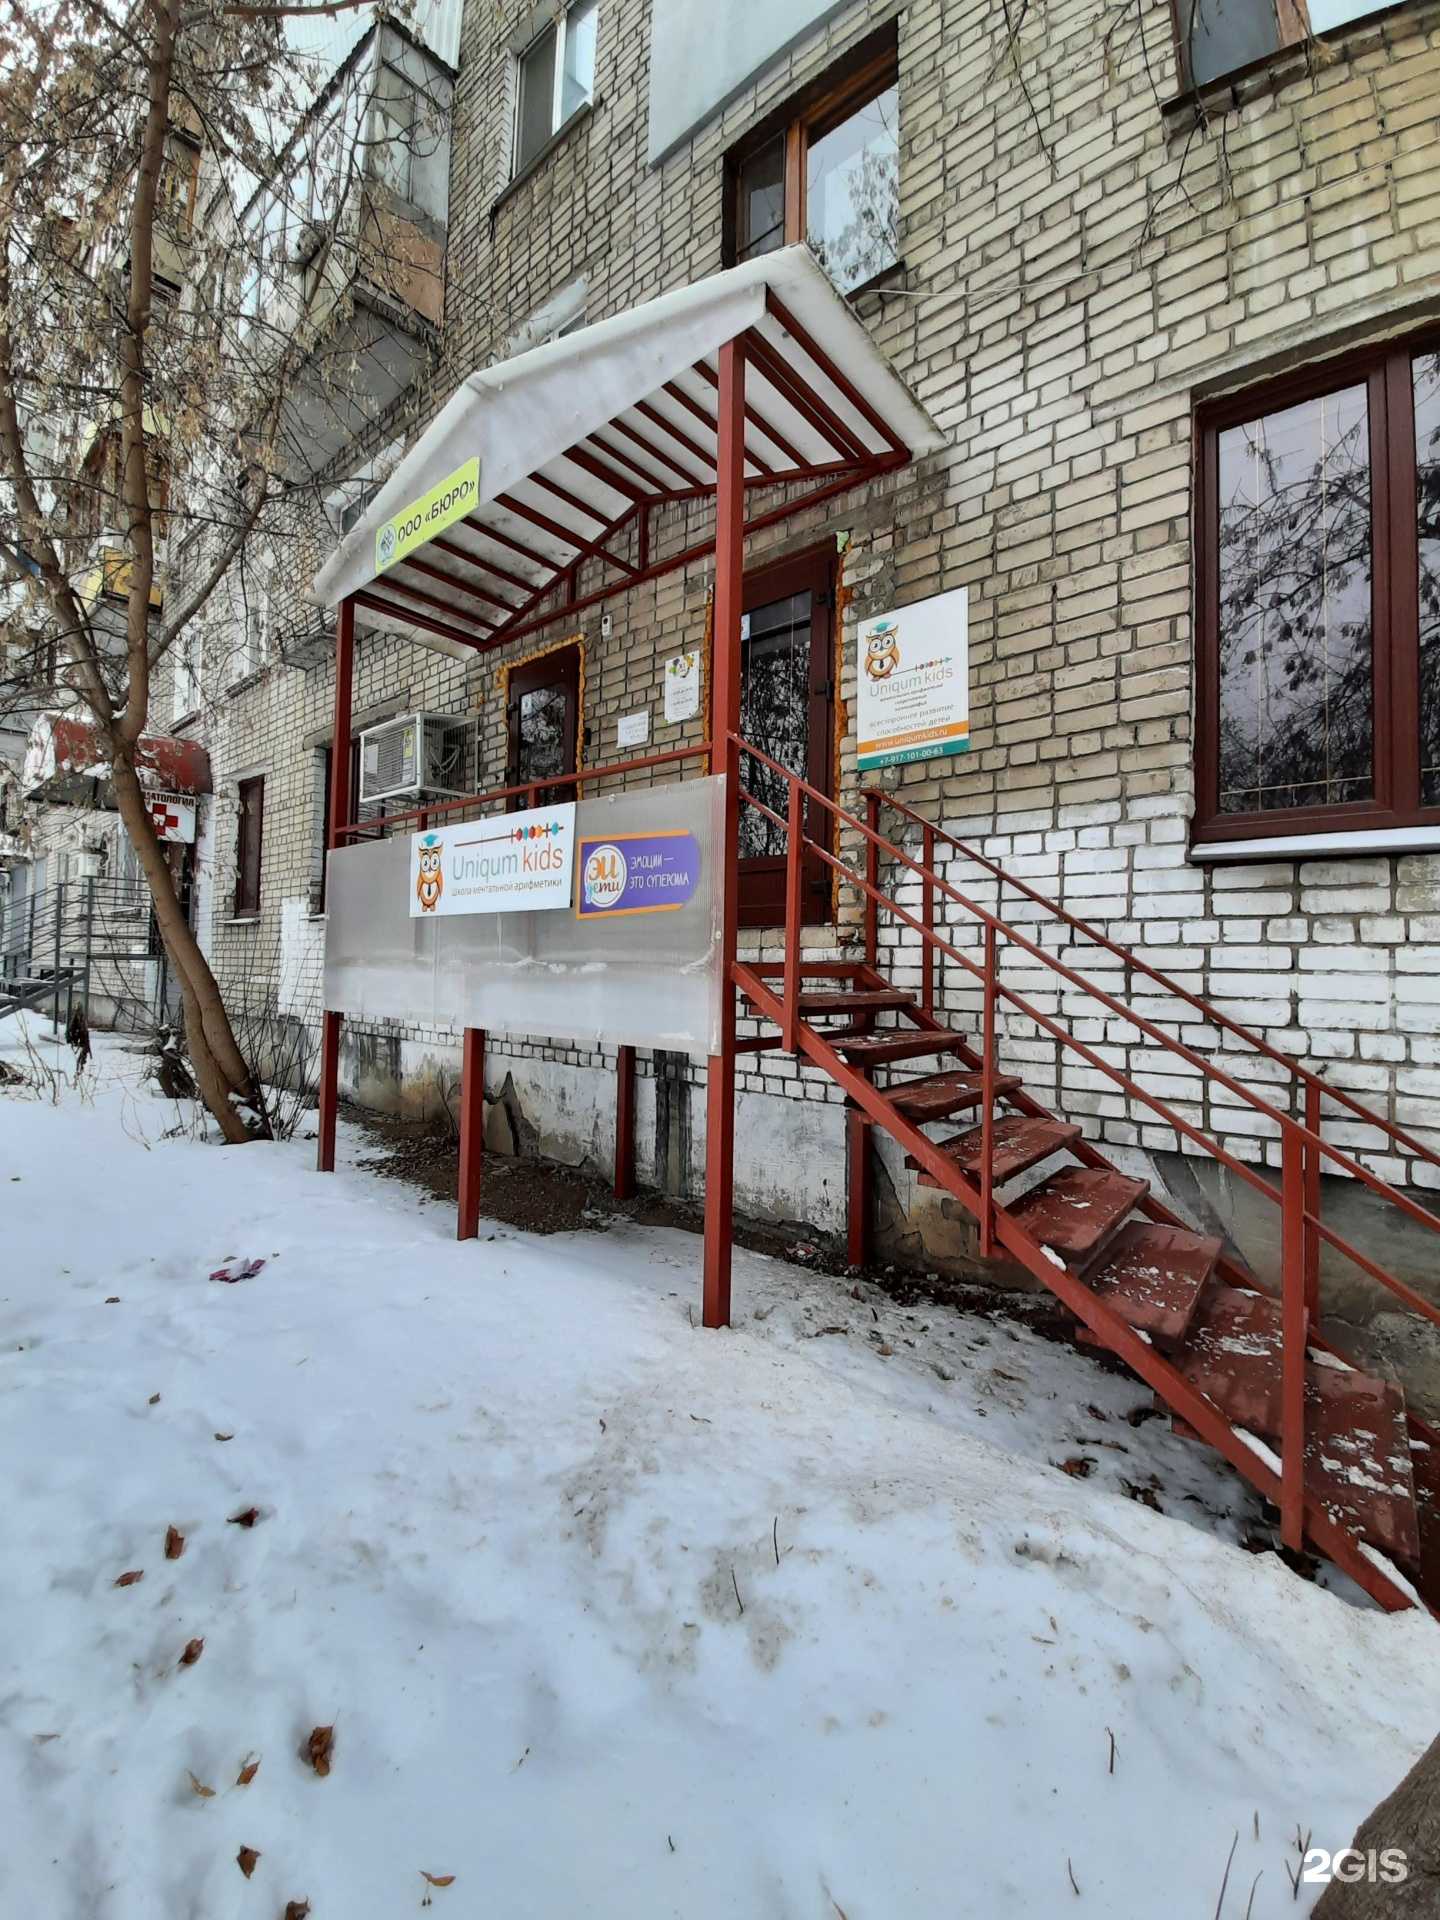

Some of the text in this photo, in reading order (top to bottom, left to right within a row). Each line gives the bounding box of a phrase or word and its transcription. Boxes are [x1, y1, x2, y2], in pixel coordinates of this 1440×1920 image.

[398, 480, 475, 543] ООО «БЮРО»
[870, 676, 921, 697] Uniqum
[924, 667, 953, 683] kids
[452, 842, 563, 883] Uniqum kids
[630, 853, 663, 870] ЭМОЦИИ
[514, 879, 562, 893] арифметики
[629, 872, 690, 889] ЭТО СУПЕРСИЛА
